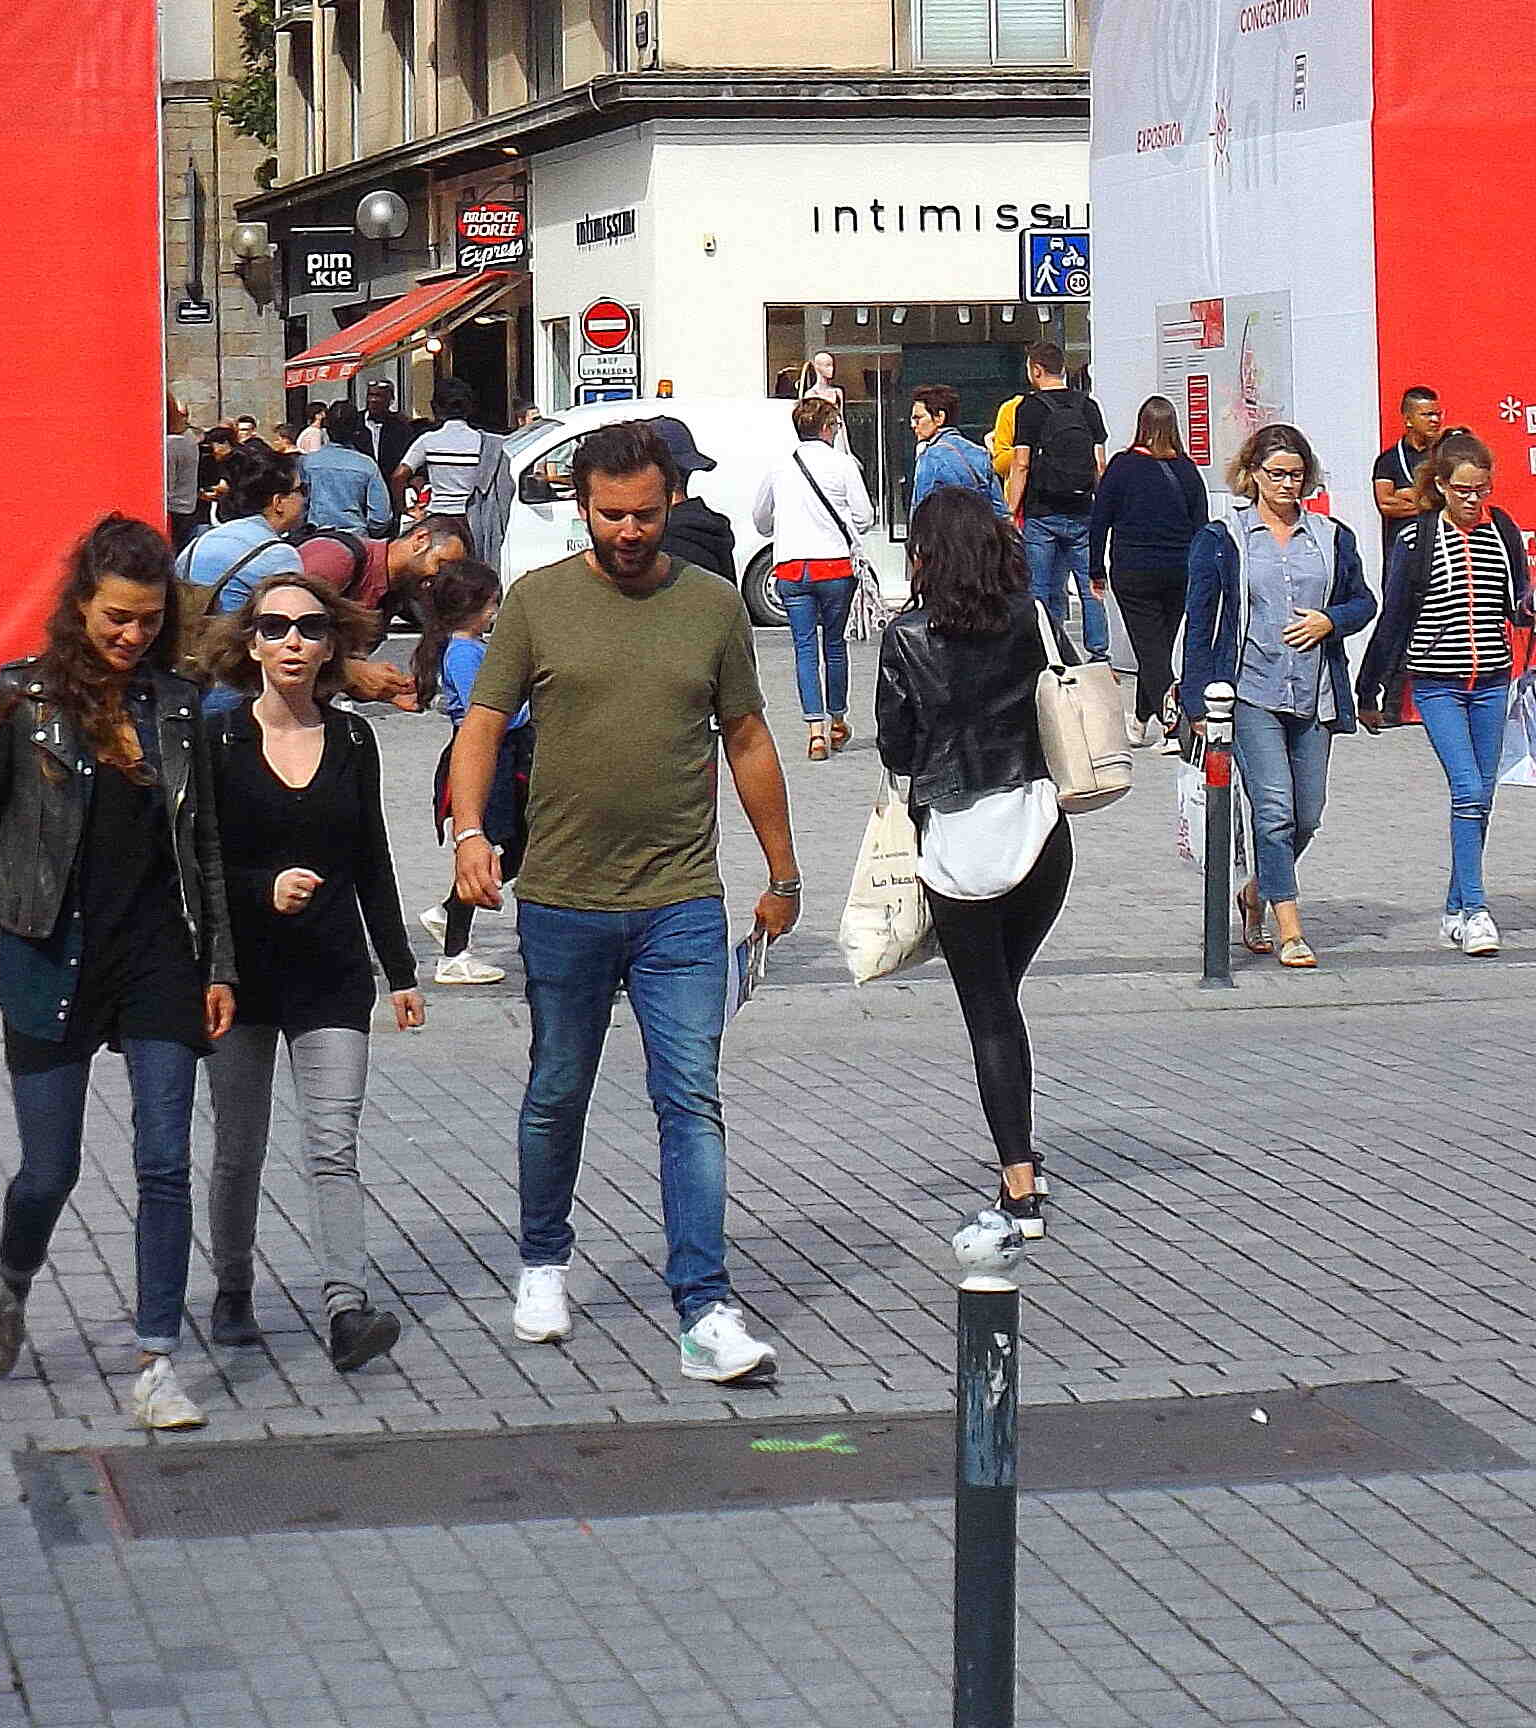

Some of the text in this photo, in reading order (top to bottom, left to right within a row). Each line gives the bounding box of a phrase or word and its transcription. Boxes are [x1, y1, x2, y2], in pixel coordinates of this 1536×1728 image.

[1136, 119, 1184, 154] EXPOSITION
[813, 198, 1090, 234] intimissi
[307, 252, 353, 272] pim
[459, 239, 524, 273] Express
[1071, 276, 1086, 289] 20
[582, 367, 634, 376] LIVRAISONS
